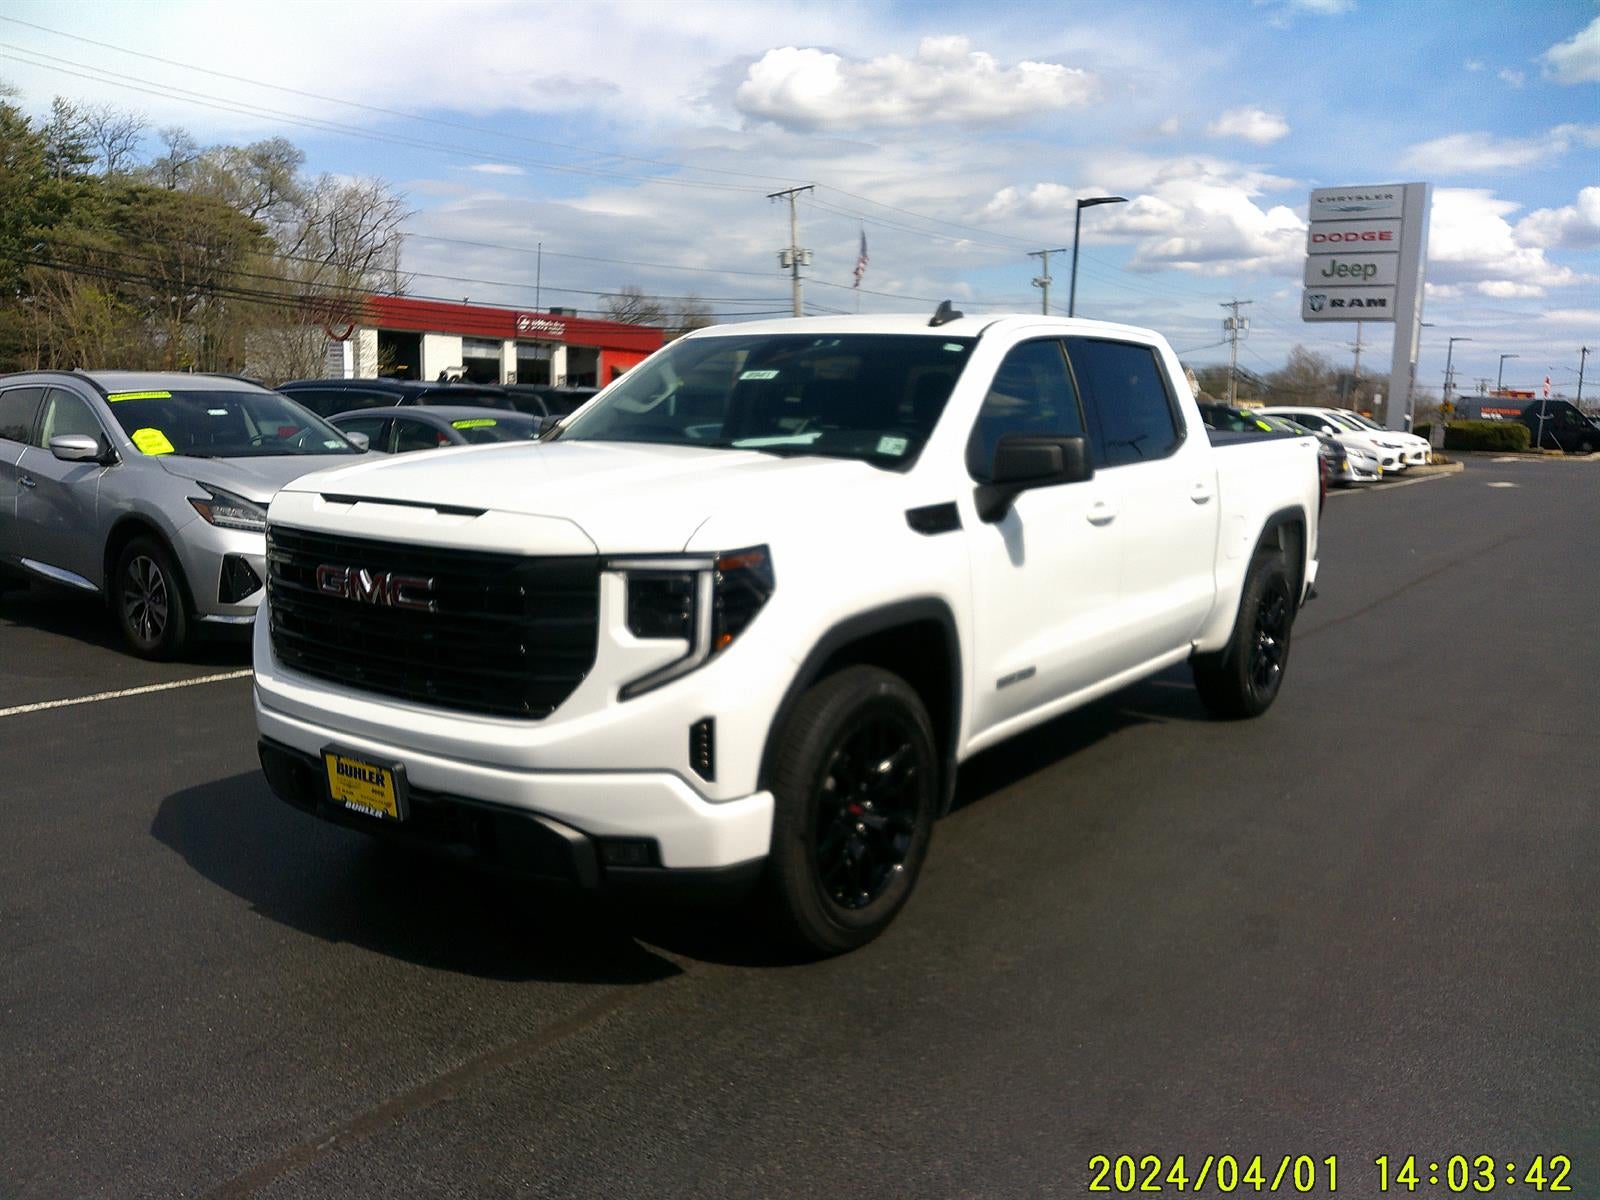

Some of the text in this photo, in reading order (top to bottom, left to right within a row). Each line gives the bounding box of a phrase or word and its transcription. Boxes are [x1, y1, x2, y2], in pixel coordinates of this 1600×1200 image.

[1318, 193, 1393, 203] CHRYSLER
[1312, 231, 1393, 243] DODGE
[1322, 259, 1377, 281] Jeep
[1331, 298, 1387, 308] RAM
[316, 564, 435, 612] GMC
[336, 762, 385, 787] BUHLER
